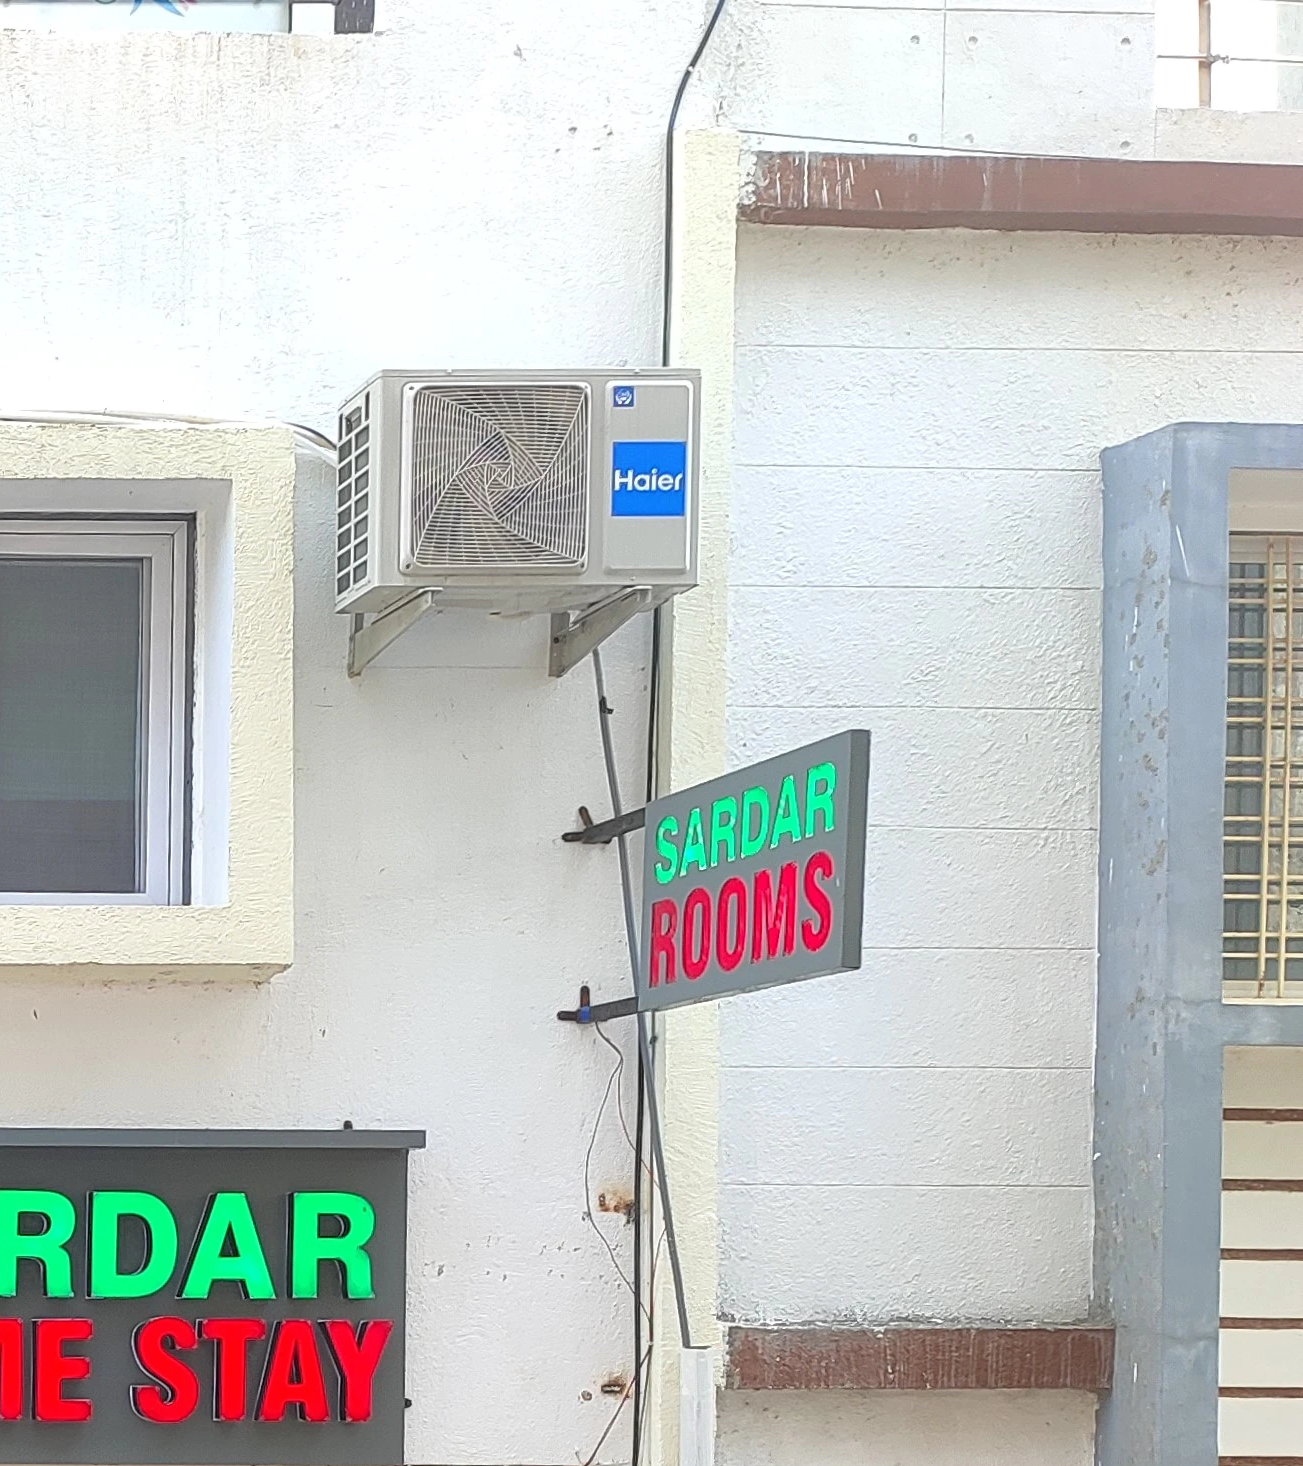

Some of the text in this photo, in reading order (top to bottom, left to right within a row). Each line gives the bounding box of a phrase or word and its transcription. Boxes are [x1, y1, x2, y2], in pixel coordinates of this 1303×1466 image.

[614, 468, 683, 491] Haier
[654, 762, 837, 884] SARDAR
[649, 851, 834, 988] ROOMS
[130, 1315, 393, 1424] STAY
